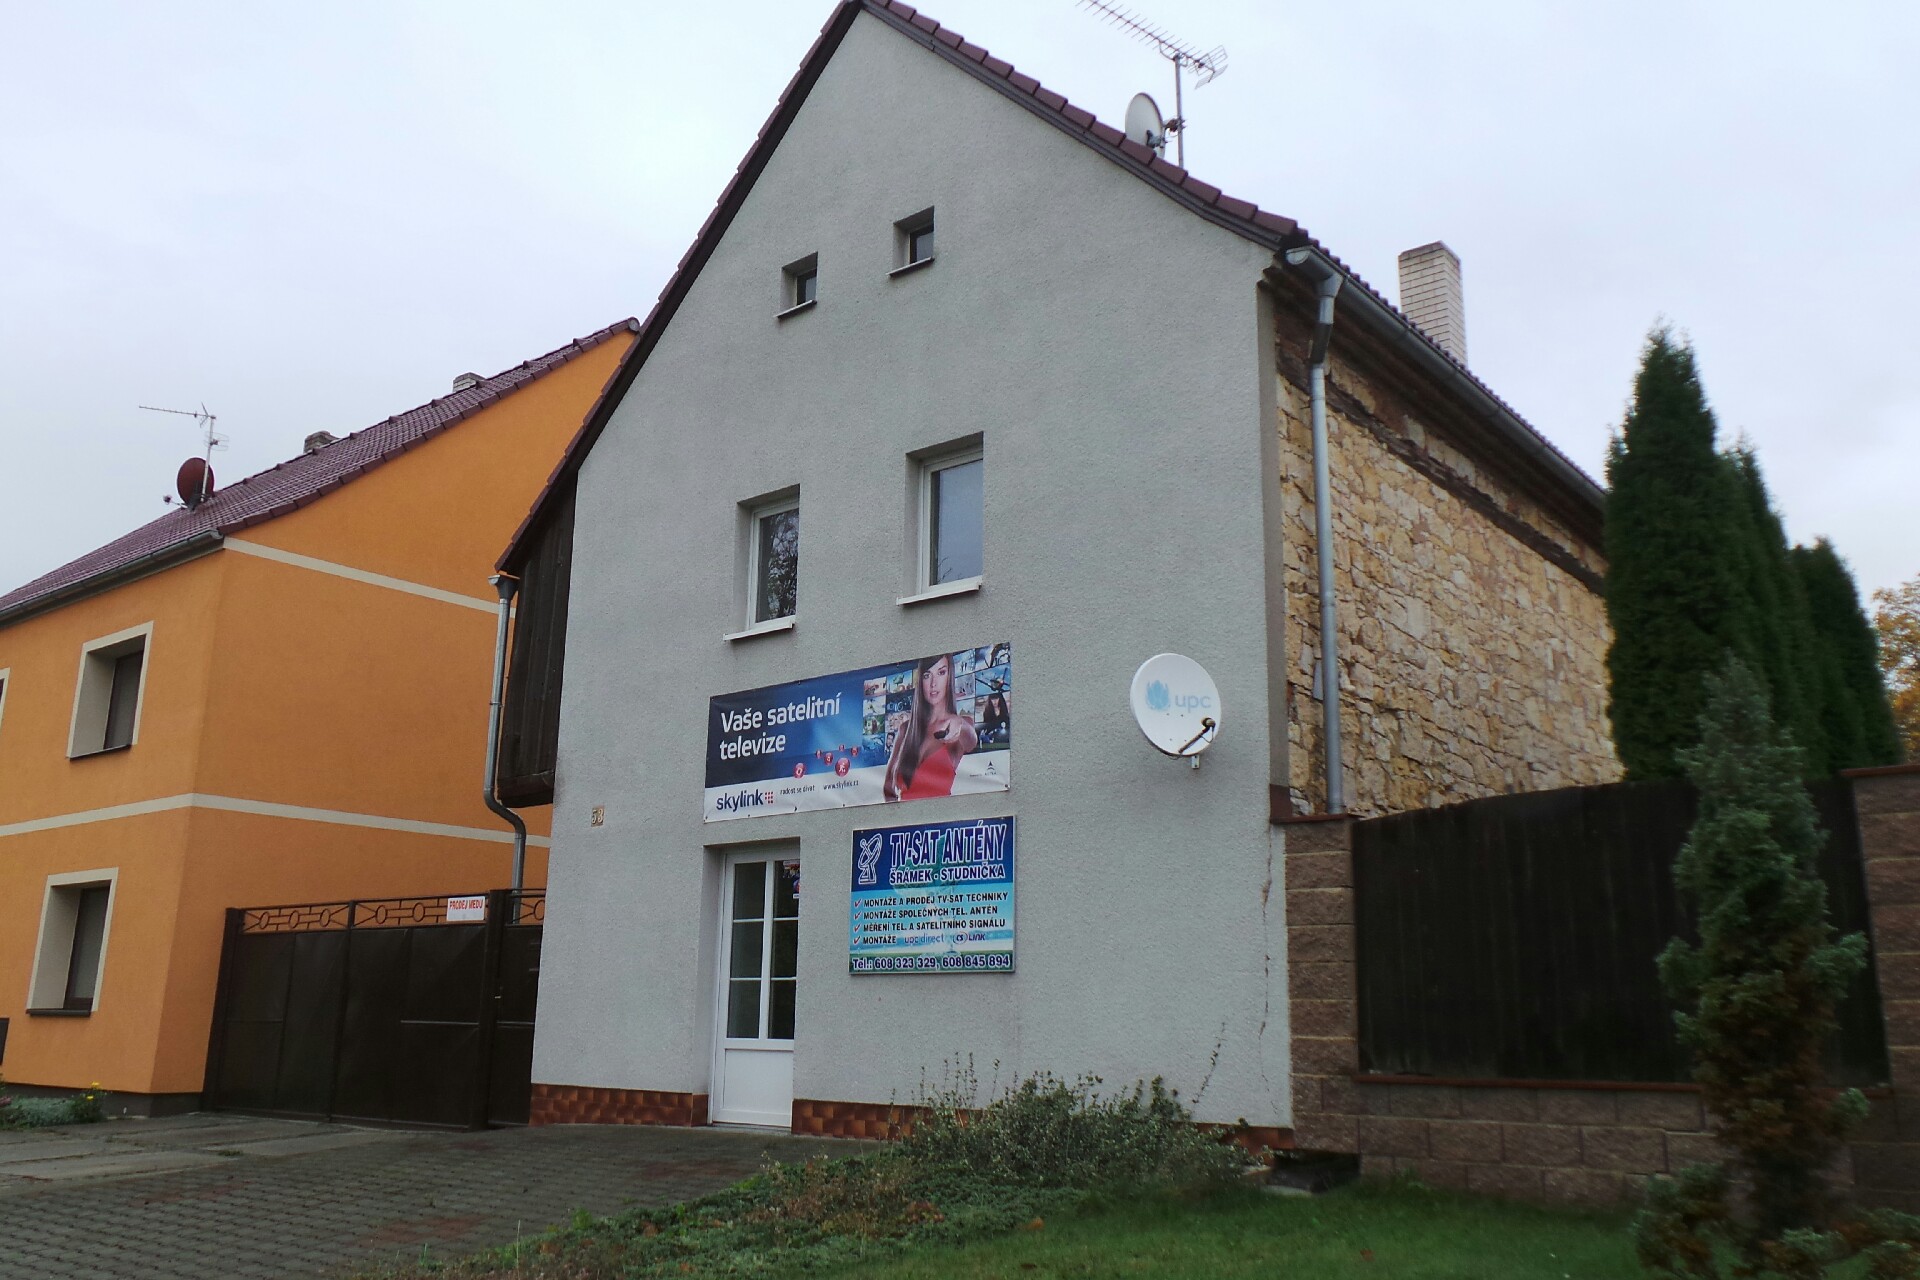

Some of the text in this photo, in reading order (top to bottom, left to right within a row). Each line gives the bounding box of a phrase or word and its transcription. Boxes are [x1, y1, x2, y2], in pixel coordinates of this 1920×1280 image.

[1174, 694, 1212, 713] upc
[721, 692, 842, 733] Vaše satelitní
[719, 731, 786, 760] televize
[716, 788, 764, 812] skylink
[592, 808, 604, 824] 53
[890, 820, 1007, 868] TV-SAT ANTÉNY
[889, 866, 932, 885] ŠRÁMEK
[940, 862, 1006, 882] STUDNIČKA
[863, 896, 897, 907] MONTÁŽE
[906, 896, 935, 905] PRODEJ
[937, 894, 963, 904] TV-SAT
[966, 892, 1008, 902] TECHNIKY
[863, 904, 998, 920] MONTÁŽE SPOLEČNÝCH TEL. ANTÉN
[863, 920, 890, 932] MĚŘENÍ
[892, 923, 907, 931] TEL.
[969, 916, 1005, 928] SIGNÁLU
[863, 934, 897, 944] MONTÁŽE
[920, 932, 944, 943] direct
[874, 957, 893, 969] 608
[895, 957, 914, 969] 323
[917, 956, 939, 970] 329,
[942, 955, 962, 968] 608
[965, 955, 985, 967] 845
[987, 954, 1010, 967] 894
